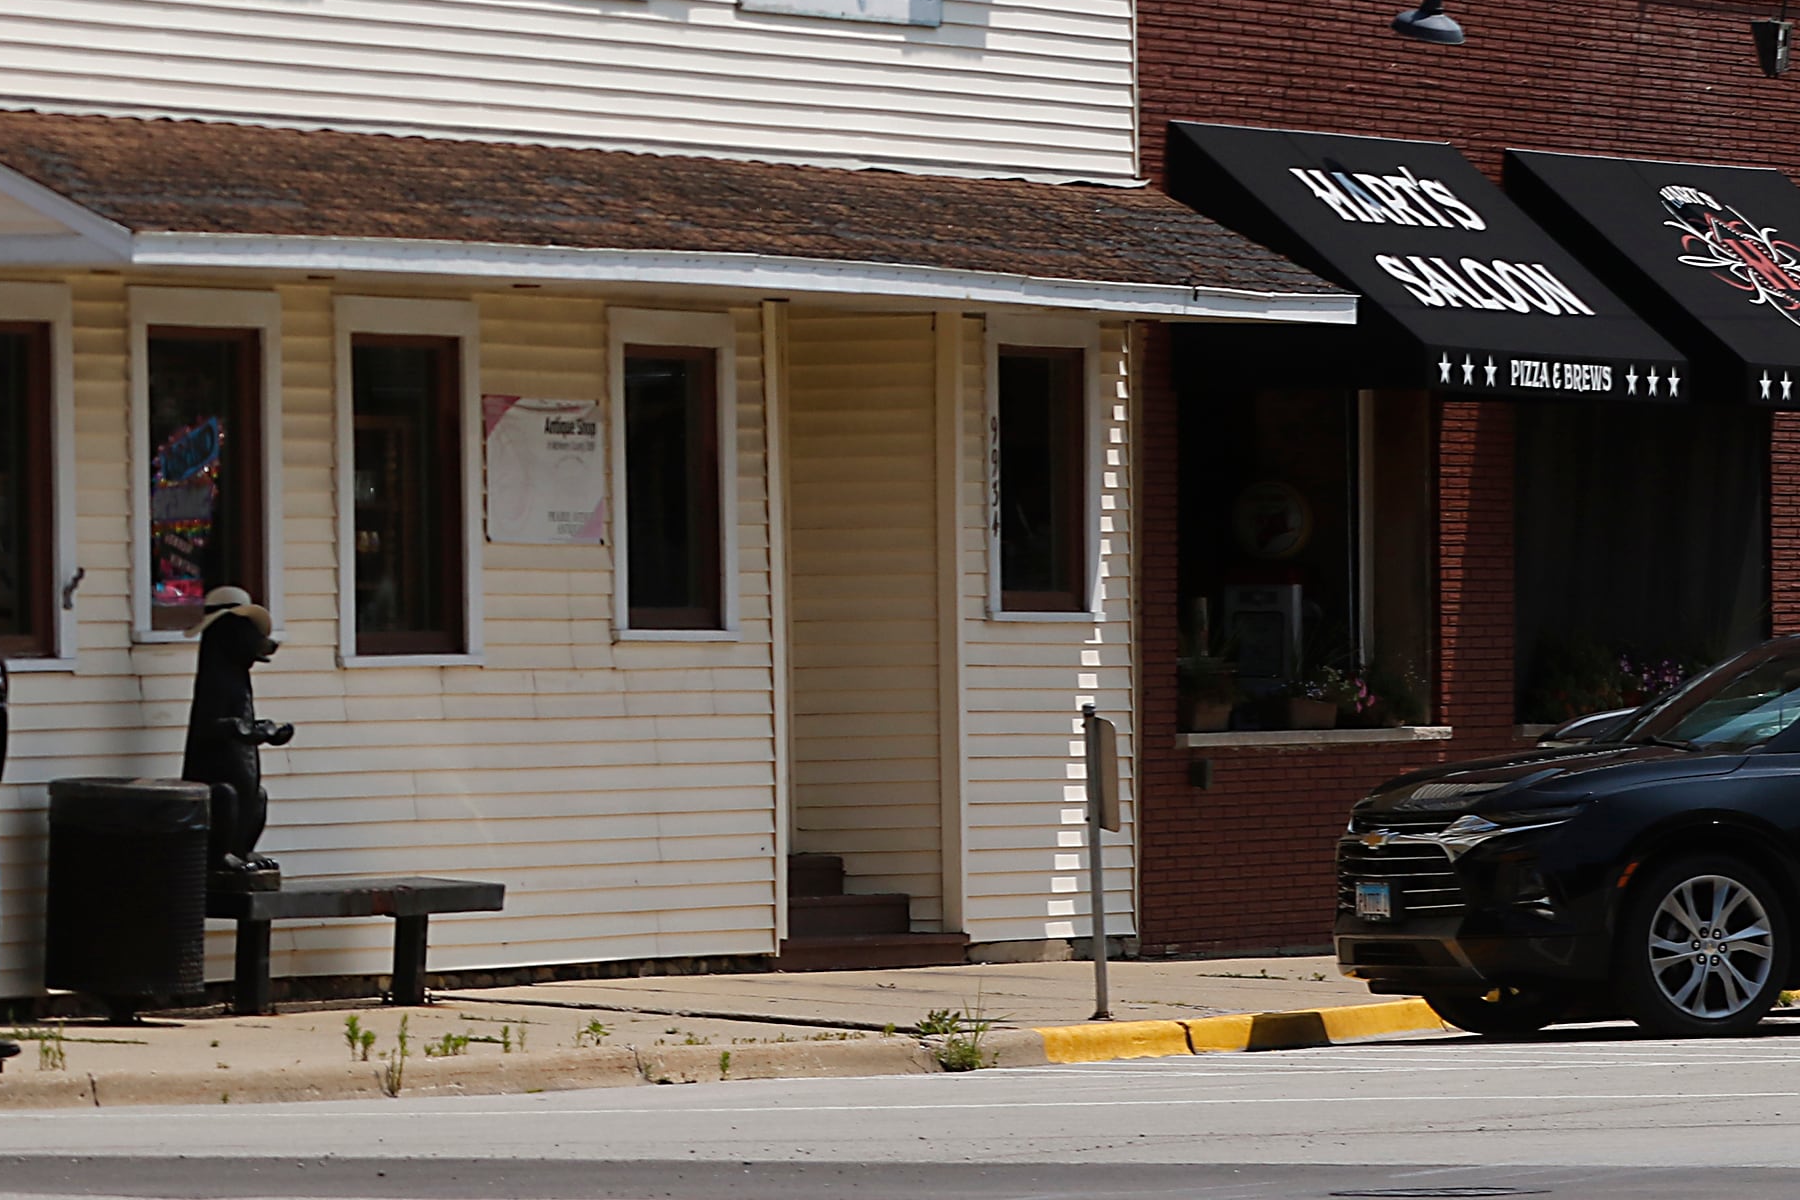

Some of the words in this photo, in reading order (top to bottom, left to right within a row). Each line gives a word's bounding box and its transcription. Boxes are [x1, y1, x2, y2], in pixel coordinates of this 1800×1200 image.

[1289, 165, 1487, 232] HART'S
[1374, 253, 1596, 317] SALOON
[1510, 359, 1551, 389] PIZZA
[1552, 362, 1562, 389] &
[1563, 362, 1613, 392] BREWS
[543, 415, 576, 440] Antique
[576, 417, 597, 439] Shop
